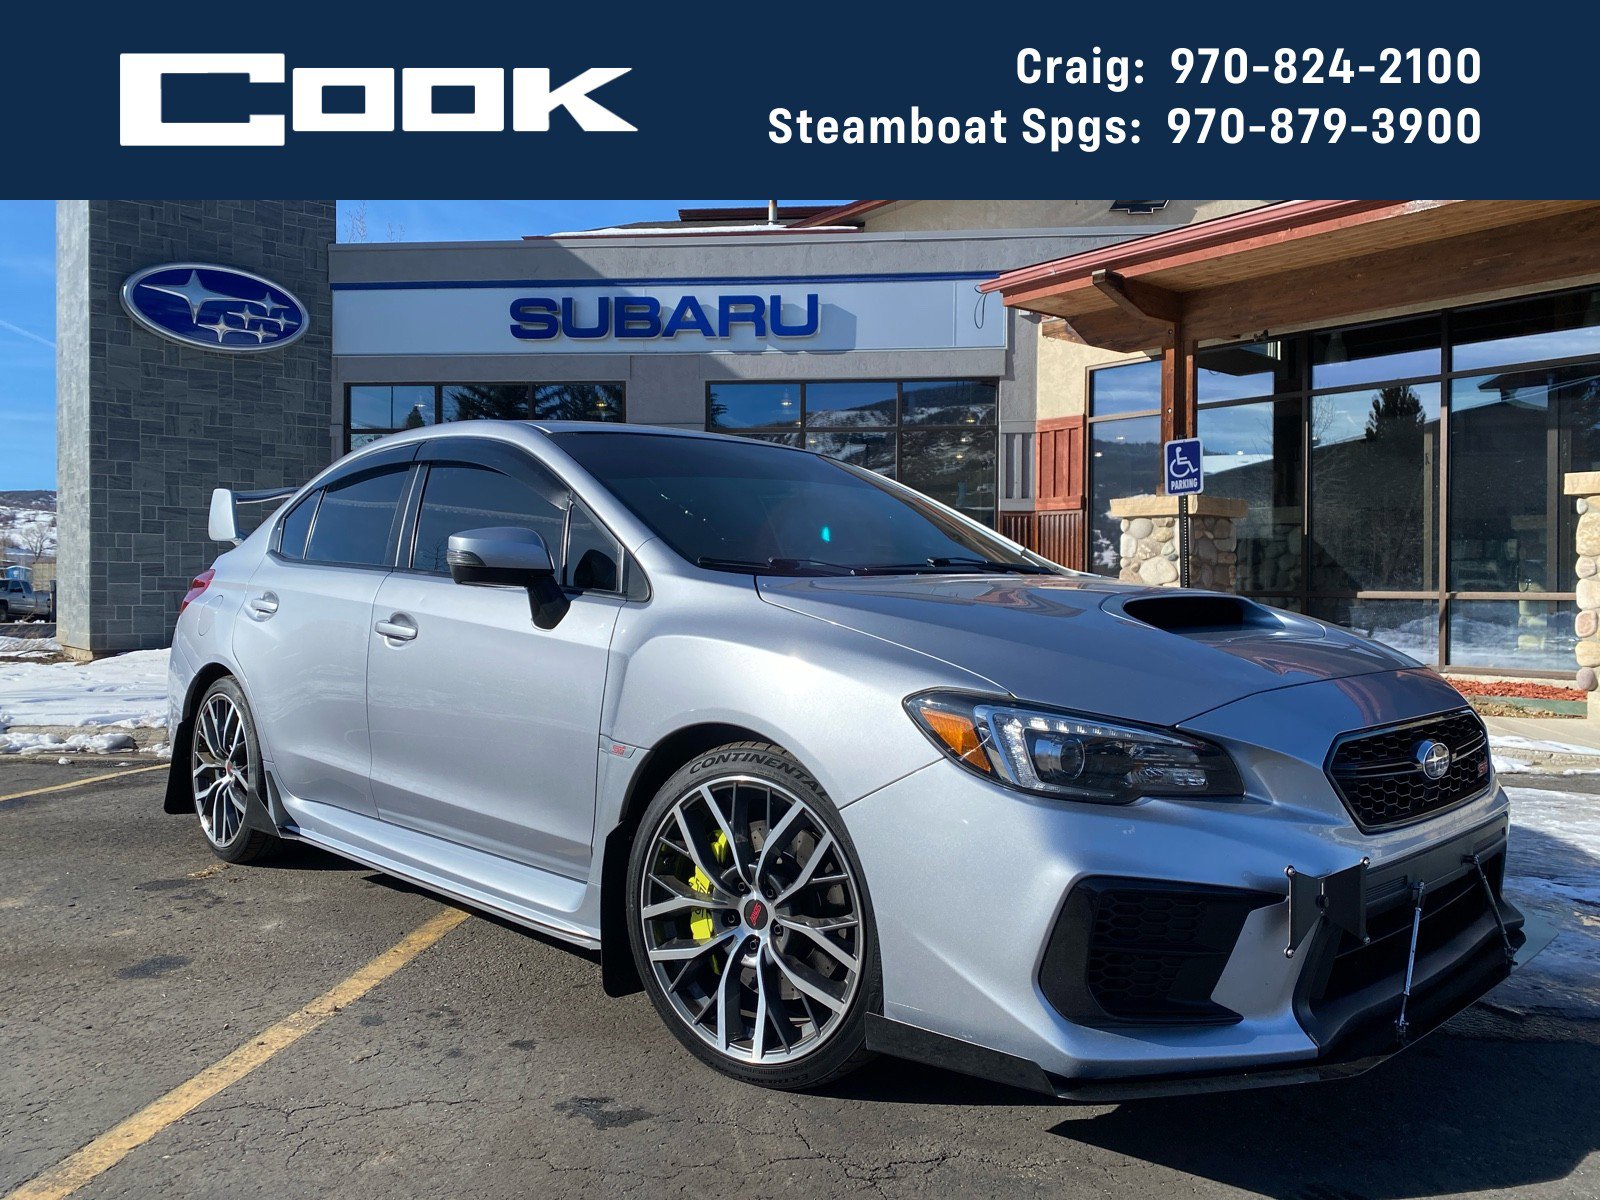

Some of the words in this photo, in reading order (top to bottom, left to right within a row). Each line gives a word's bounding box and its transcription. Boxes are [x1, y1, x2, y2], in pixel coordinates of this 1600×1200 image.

[509, 294, 820, 340] SUBARU
[1171, 478, 1198, 490] PARKING
[690, 752, 828, 802] CONTINENTAL
